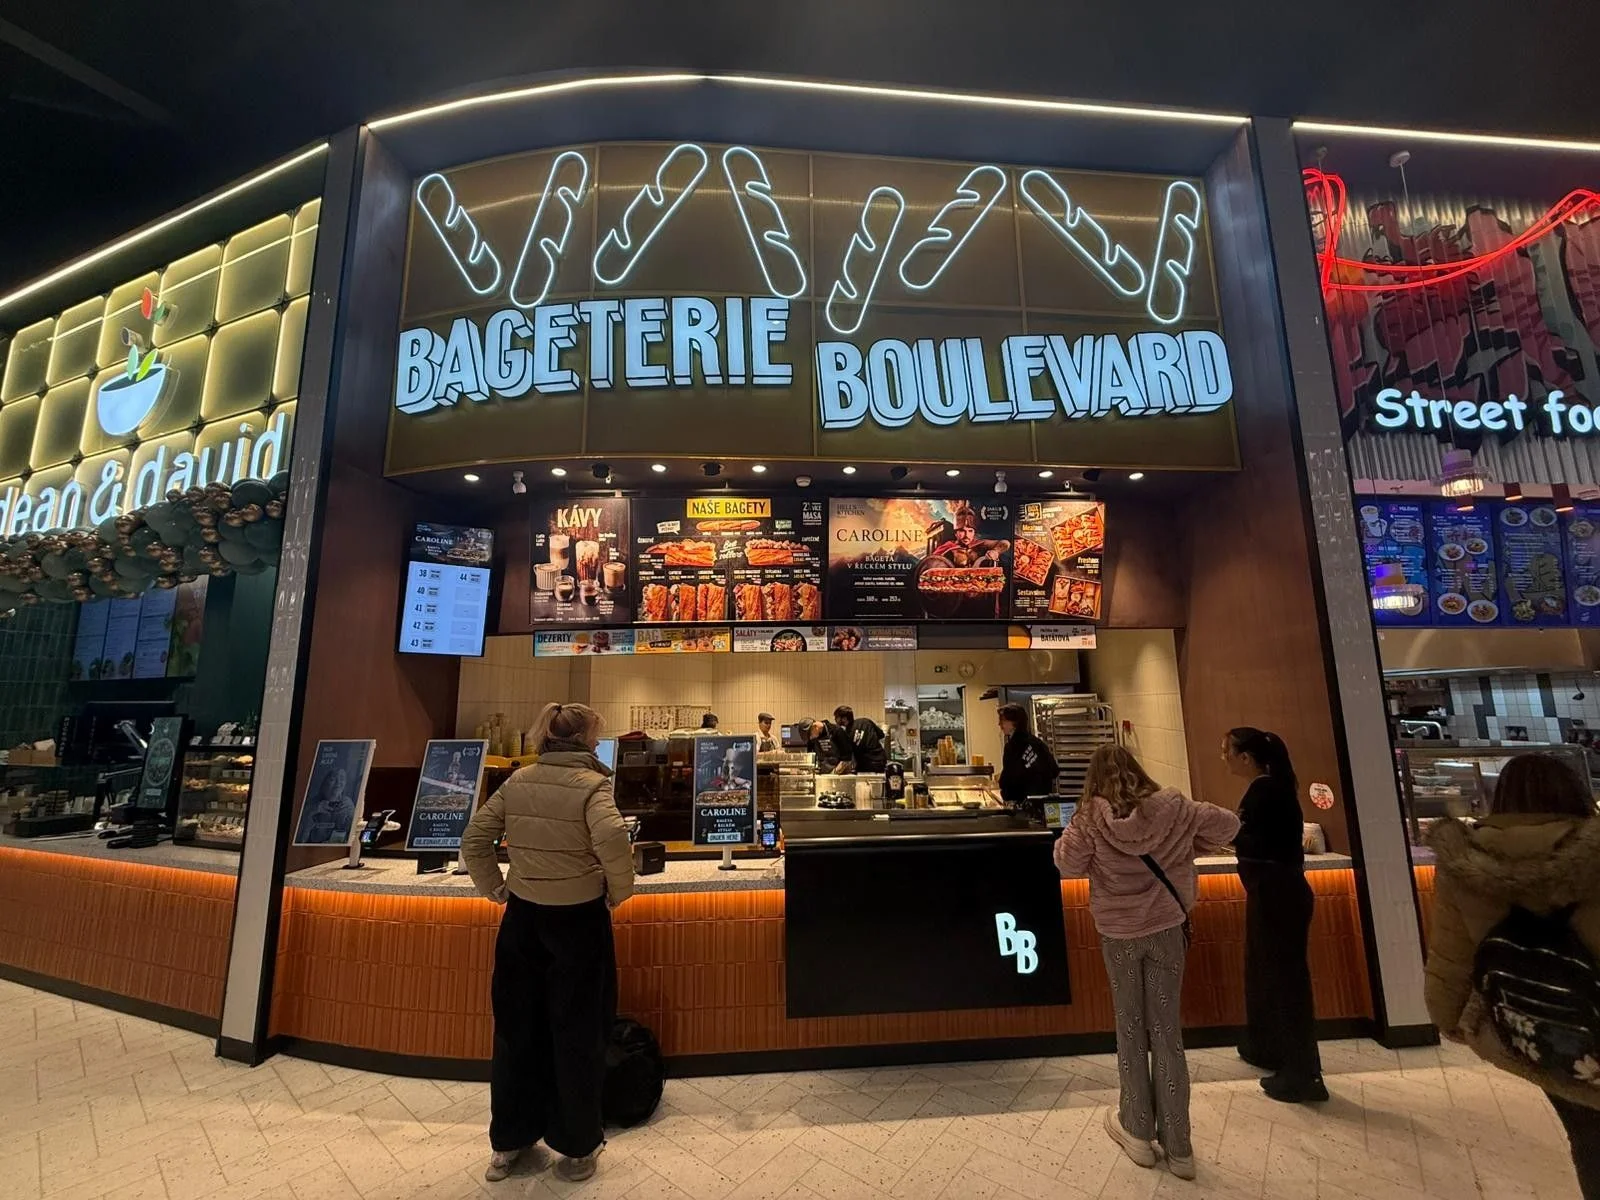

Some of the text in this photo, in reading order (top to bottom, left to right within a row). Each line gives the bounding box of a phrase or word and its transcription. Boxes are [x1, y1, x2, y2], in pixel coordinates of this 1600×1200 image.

[395, 296, 1235, 430] BAGETERIE BOULEVARD
[1375, 388, 1527, 431] Street
[90, 459, 124, 525] &
[692, 500, 766, 515] NAŠE BAGETY
[557, 504, 603, 528] KÁVY
[803, 511, 822, 520] MASA
[415, 535, 454, 545] CAROLINE
[836, 529, 924, 542] CAROLINE
[419, 569, 427, 577] 38
[459, 573, 467, 581] 44
[415, 604, 422, 612] 41
[413, 621, 421, 629] 42
[736, 628, 757, 637] SALÁTY
[410, 639, 418, 647] 43
[538, 633, 572, 643] DEZERTY
[419, 812, 465, 821] CAROLINE
[700, 807, 747, 817] CAROLINE
[995, 912, 1039, 973] BB
